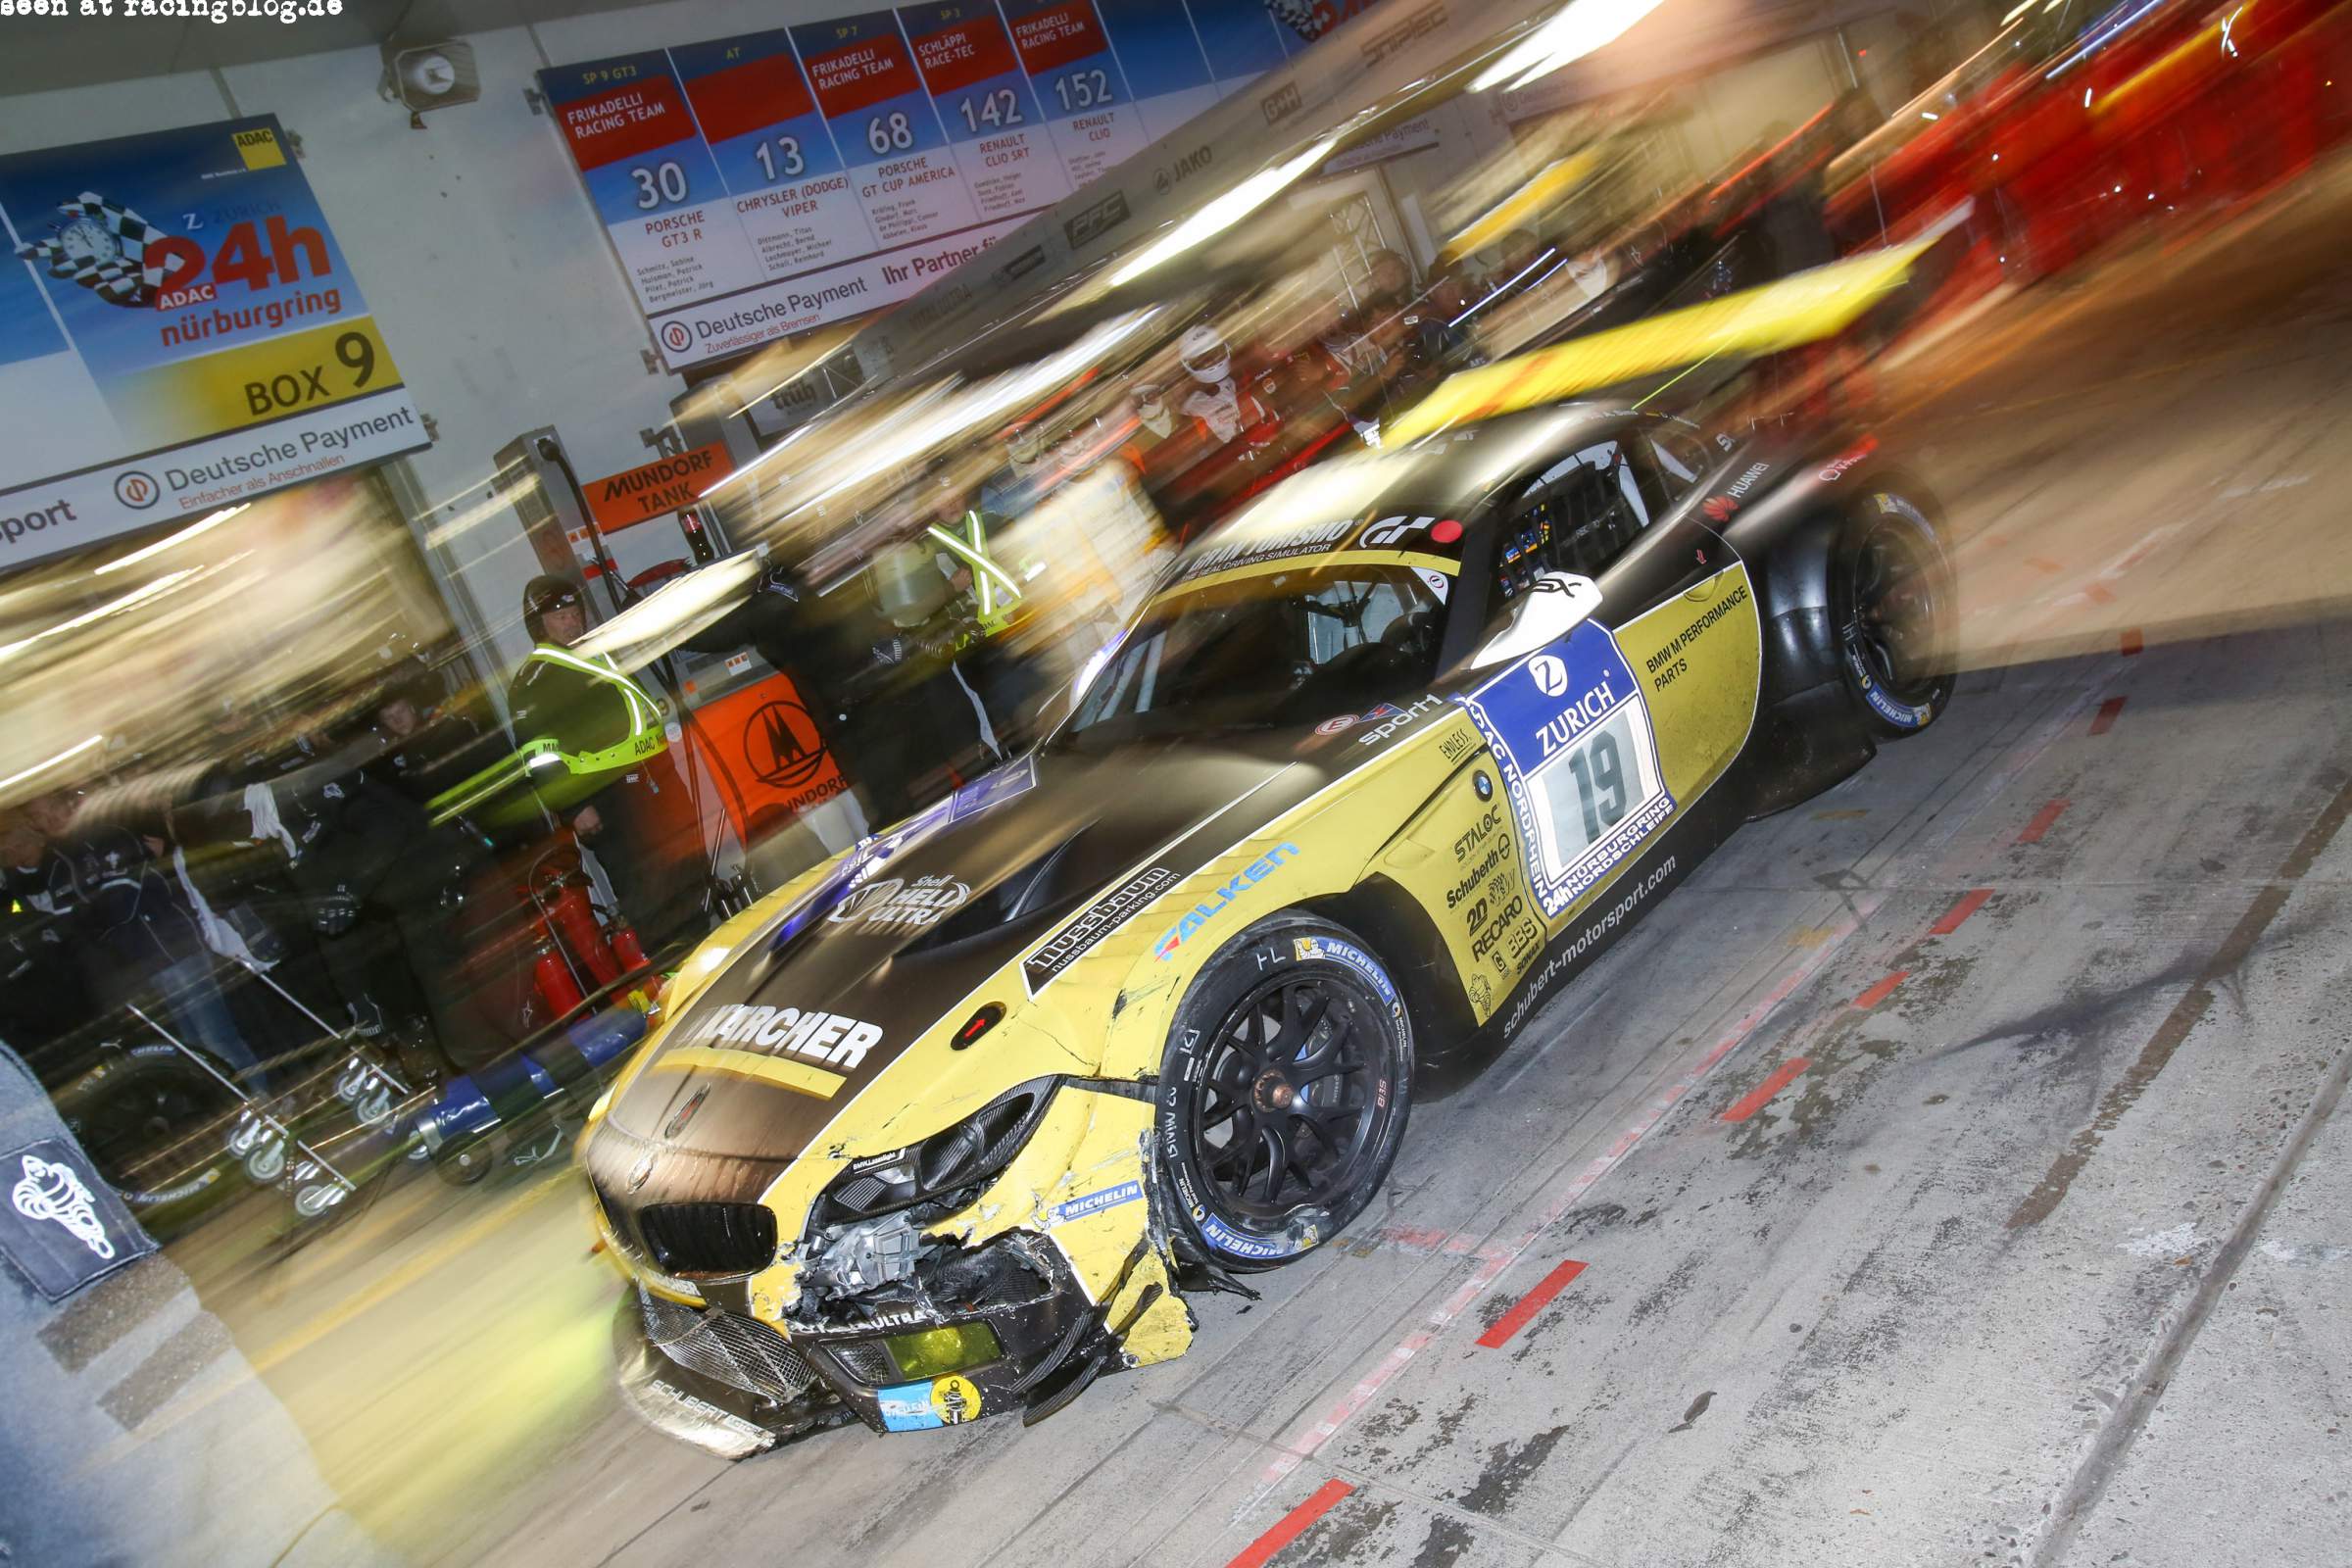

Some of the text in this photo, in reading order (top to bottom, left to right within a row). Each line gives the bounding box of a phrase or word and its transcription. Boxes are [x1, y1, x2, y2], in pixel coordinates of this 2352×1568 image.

[1015, 13, 1069, 37] FRIKADELLI
[1021, 22, 1085, 49] RACING TEAM
[811, 49, 875, 77] FRIKADELLI
[918, 32, 966, 57] SCHLÄPPI
[924, 45, 975, 70] RACE-TEC
[582, 66, 637, 85] SP 9 GT3
[818, 58, 894, 90] RACING TEAM
[1054, 70, 1113, 111] 152
[566, 93, 644, 125] FRIKADELLI
[574, 102, 666, 140] RACING TEAM
[960, 89, 1023, 132] 142
[1072, 113, 1114, 131] RENAULT
[235, 130, 273, 147] ADAC
[867, 112, 913, 155] 68
[980, 134, 1025, 154] RENAULT
[1089, 128, 1111, 142] CLIO
[755, 136, 806, 181] 13
[878, 157, 928, 178] PORSCHE
[985, 153, 1008, 168] CLIO
[1172, 146, 1213, 183] JAKO
[631, 163, 686, 210] 30
[737, 177, 850, 214] CHRYSLER (DODGE)
[862, 167, 956, 198] GT CUP AMERICA
[183, 213, 205, 230] Z
[645, 211, 705, 234] PORSCHE
[782, 200, 818, 219] VIPER
[145, 214, 332, 297] 24h
[662, 228, 703, 248] GT3 R
[882, 266, 908, 285] Ihr
[911, 245, 979, 276] Partner
[160, 284, 216, 310] ADAC
[695, 300, 786, 339] Deutsche
[787, 276, 868, 314] Payment
[161, 288, 342, 347] nürburgring
[705, 314, 821, 355] Zuverlässiger als Bremsen
[244, 331, 375, 416] BOX 9
[165, 406, 415, 493] Deutsche Payment
[179, 453, 346, 511] Einfacher als Anschnallen
[604, 451, 713, 502] MUNDORF
[1728, 462, 1770, 499] HUAWEI
[637, 481, 699, 514] TANK
[0, 499, 77, 546] port
[1189, 518, 1353, 573] GRAN TURISMO
[1223, 554, 1265, 570] DRIVING
[1265, 543, 1332, 561] SIMULATOR
[1646, 585, 1748, 674] BMW M PERFORMANCE
[1534, 660, 1563, 694] Z
[1653, 658, 1688, 692] PARTS
[1536, 680, 1616, 758] ZURICH
[1870, 690, 1913, 723] MICHELIN
[635, 736, 656, 756] ADAC
[1568, 729, 1627, 846] 19
[1454, 805, 1501, 863] STALOC
[1503, 763, 1548, 897] NORDRHEIN
[1566, 796, 1671, 889] NÜRBURGRING
[1569, 804, 1674, 896] NORDSCHLEIFE
[910, 873, 955, 887] Shell
[1446, 849, 1499, 909] Schuberth
[868, 906, 947, 926] ULTRA
[1031, 867, 1172, 967] nussbaum
[1153, 841, 1300, 963] FALKEN
[1542, 885, 1574, 917] 24h
[1052, 872, 1181, 973] nussbaum-parking.com
[1472, 895, 1523, 962] RECARO
[1506, 917, 1538, 959] BBS
[1503, 855, 1677, 1040] schubert-motorsport.com
[1327, 942, 1391, 997] MICHELIN
[1398, 1016, 1407, 1048] MICHELIN
[1065, 1184, 1138, 1216] MICHELIN
[1179, 1178, 1194, 1208] MICHELIN
[1204, 1222, 1283, 1258] MICHELIN
[871, 1310, 927, 1330] ULTRA
[651, 1379, 729, 1420] SCHUBERT
